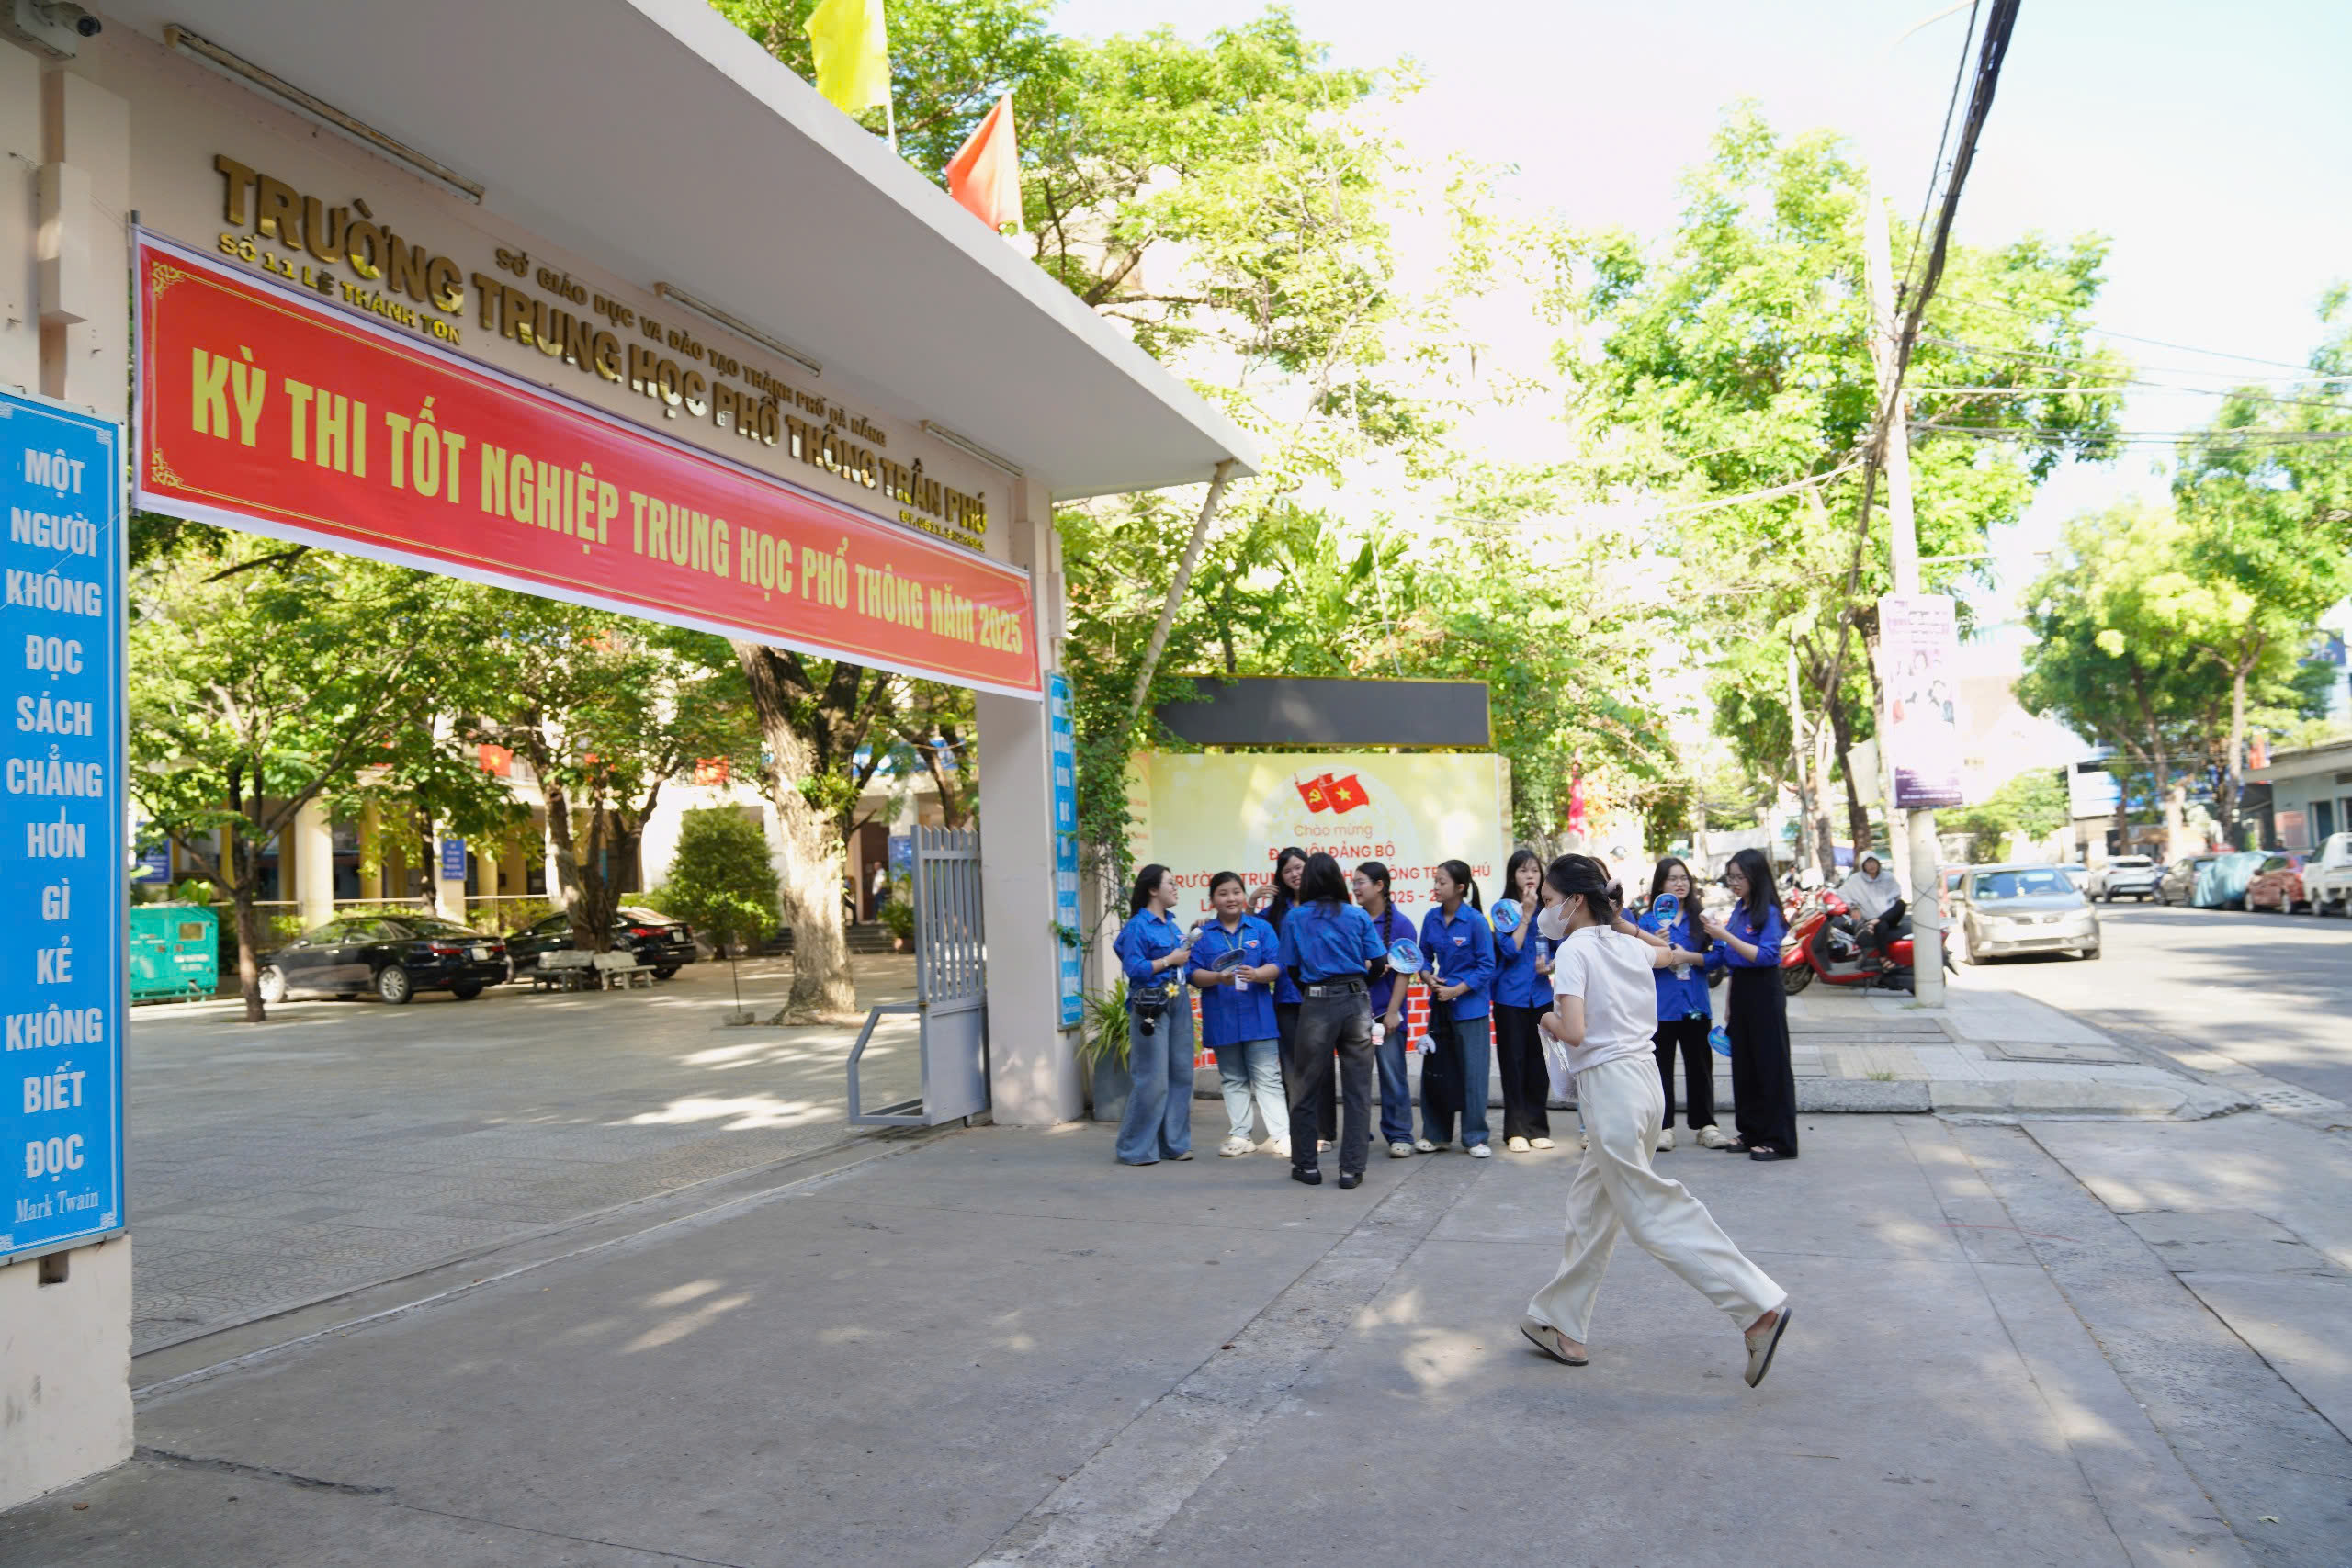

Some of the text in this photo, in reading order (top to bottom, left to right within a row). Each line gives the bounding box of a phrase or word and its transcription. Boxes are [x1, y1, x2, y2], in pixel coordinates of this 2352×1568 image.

[262, 251, 299, 281] 11
[213, 153, 463, 316] TRƯỜNG
[471, 272, 623, 383] TRUNG
[628, 344, 707, 419] HỌC
[786, 413, 876, 489] THÔNG
[944, 486, 987, 534] PHÚ
[25, 448, 85, 498] MỘT
[193, 345, 1023, 655] KỲ THI TỐT NGHIỆP TRUNG HỌC PHỔ THÔNG NĂM 2025
[11, 506, 96, 558] NGƯỜI
[6, 568, 102, 617] KHÔNG
[25, 634, 84, 680] ĐỌC
[16, 691, 93, 736] SÁCH
[6, 744, 103, 797] CHẲNG
[27, 805, 86, 858] HƠN
[1375, 840, 1395, 860] BỘ
[1471, 861, 1491, 877] HÚ
[41, 877, 70, 920] GÌ
[1389, 890, 1414, 904] 025
[37, 935, 73, 985] KẺ
[6, 1004, 103, 1051] KHÔNG
[23, 1060, 86, 1114] BIẾT
[25, 1134, 85, 1181] ĐỌC
[15, 1186, 99, 1223] Mark Twain
